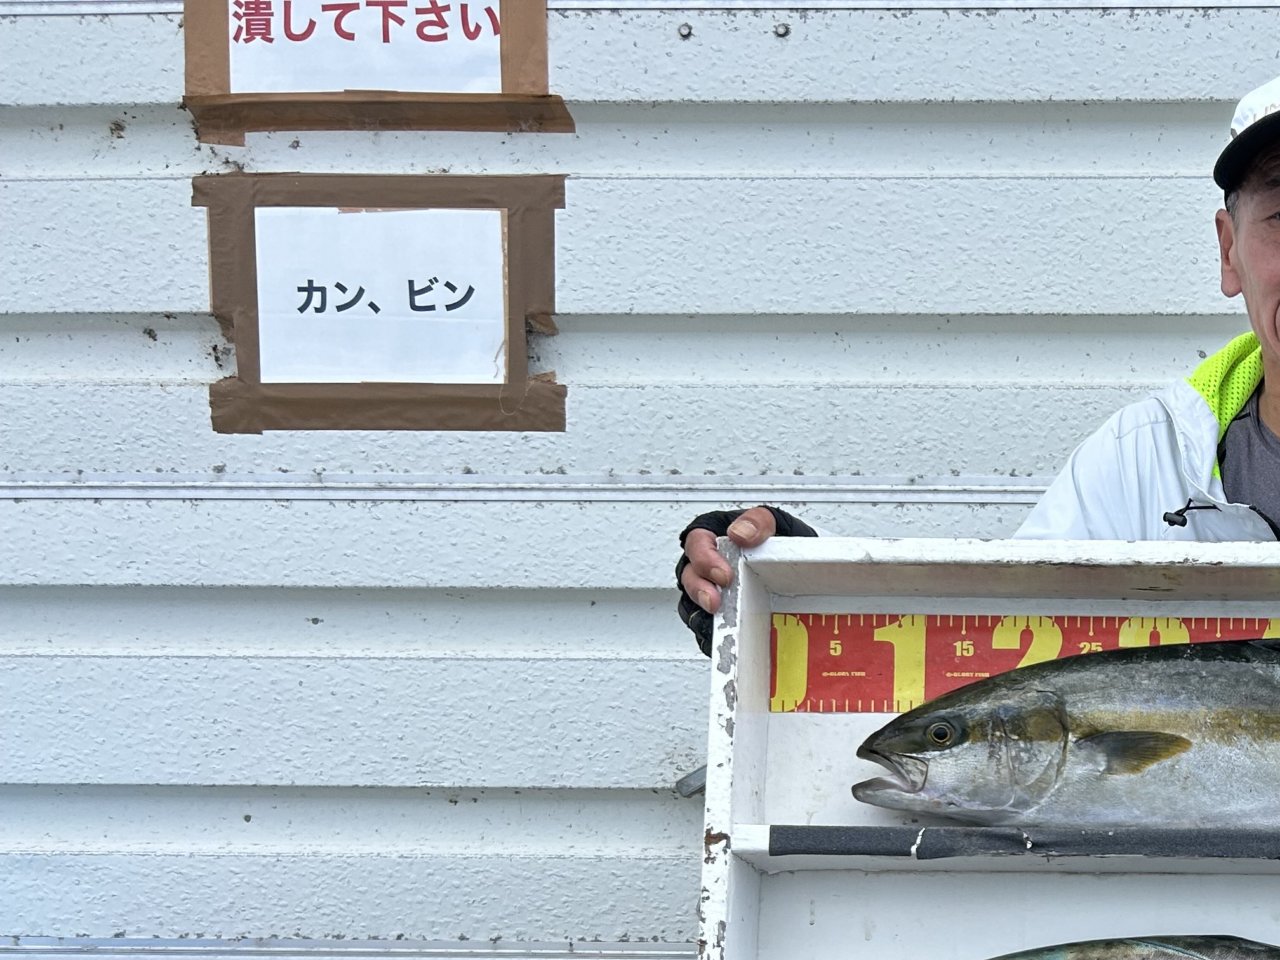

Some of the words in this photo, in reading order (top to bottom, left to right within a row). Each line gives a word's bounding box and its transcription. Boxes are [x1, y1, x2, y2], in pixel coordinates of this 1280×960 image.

[296, 277, 476, 314] カン、ビン
[829, 640, 842, 656] 5
[874, 615, 926, 712] 1
[953, 640, 975, 656] 15
